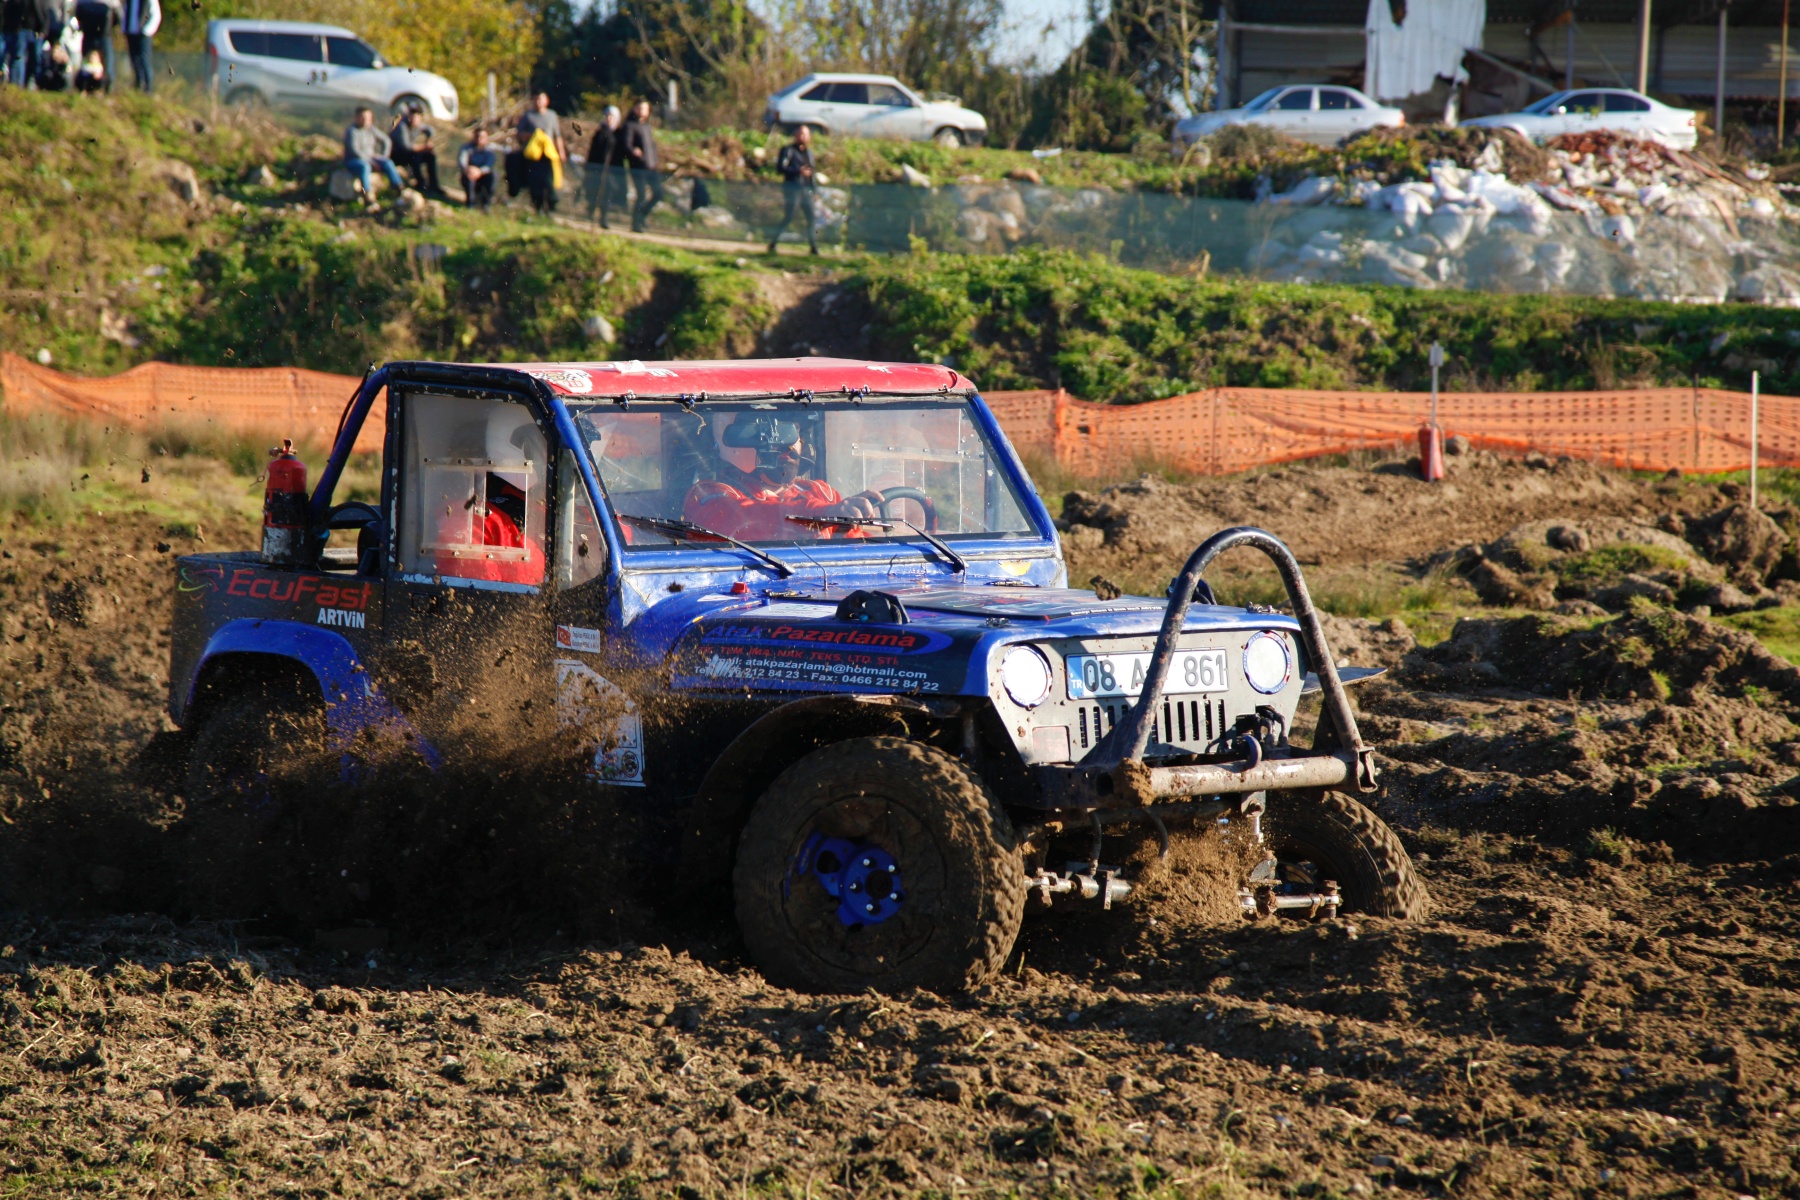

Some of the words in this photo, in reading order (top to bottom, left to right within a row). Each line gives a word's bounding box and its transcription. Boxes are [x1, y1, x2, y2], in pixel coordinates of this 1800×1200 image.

[226, 569, 372, 609] EcuFast
[771, 626, 916, 647] Pazarlama
[745, 658, 928, 680] atakpazarlama@hotmail.com
[768, 669, 783, 678] 84
[785, 670, 800, 679] 23
[811, 672, 838, 682] Fax:
[842, 674, 872, 685] 0466
[875, 678, 900, 688] 212
[902, 679, 919, 689] 84
[922, 681, 940, 691] 22
[1083, 659, 1117, 692] 08
[1184, 654, 1225, 688] 861
[1071, 679, 1083, 689] TR
